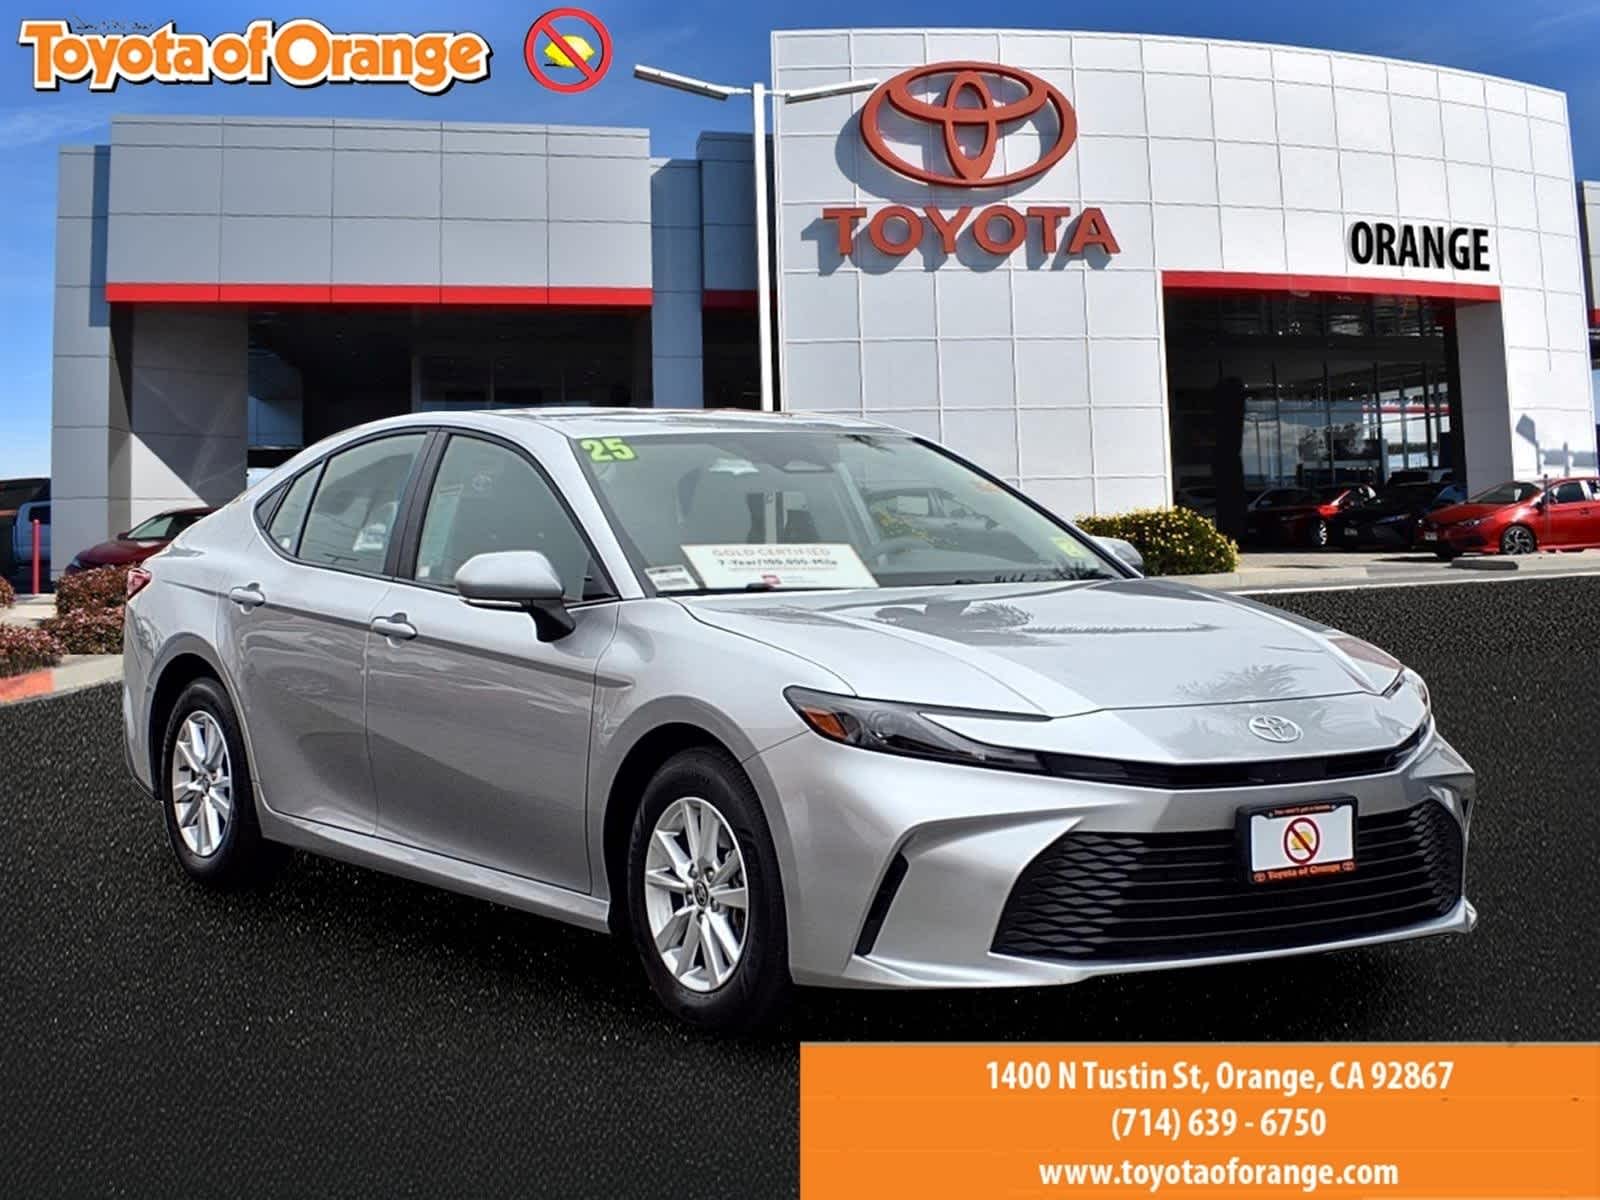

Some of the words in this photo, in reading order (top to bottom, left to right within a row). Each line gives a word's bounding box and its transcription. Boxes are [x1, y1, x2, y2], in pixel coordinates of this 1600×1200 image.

[822, 205, 1120, 256] TOYOTA
[1350, 221, 1490, 271] ORANGE
[580, 437, 637, 461] 25
[712, 548, 754, 557] GOLD
